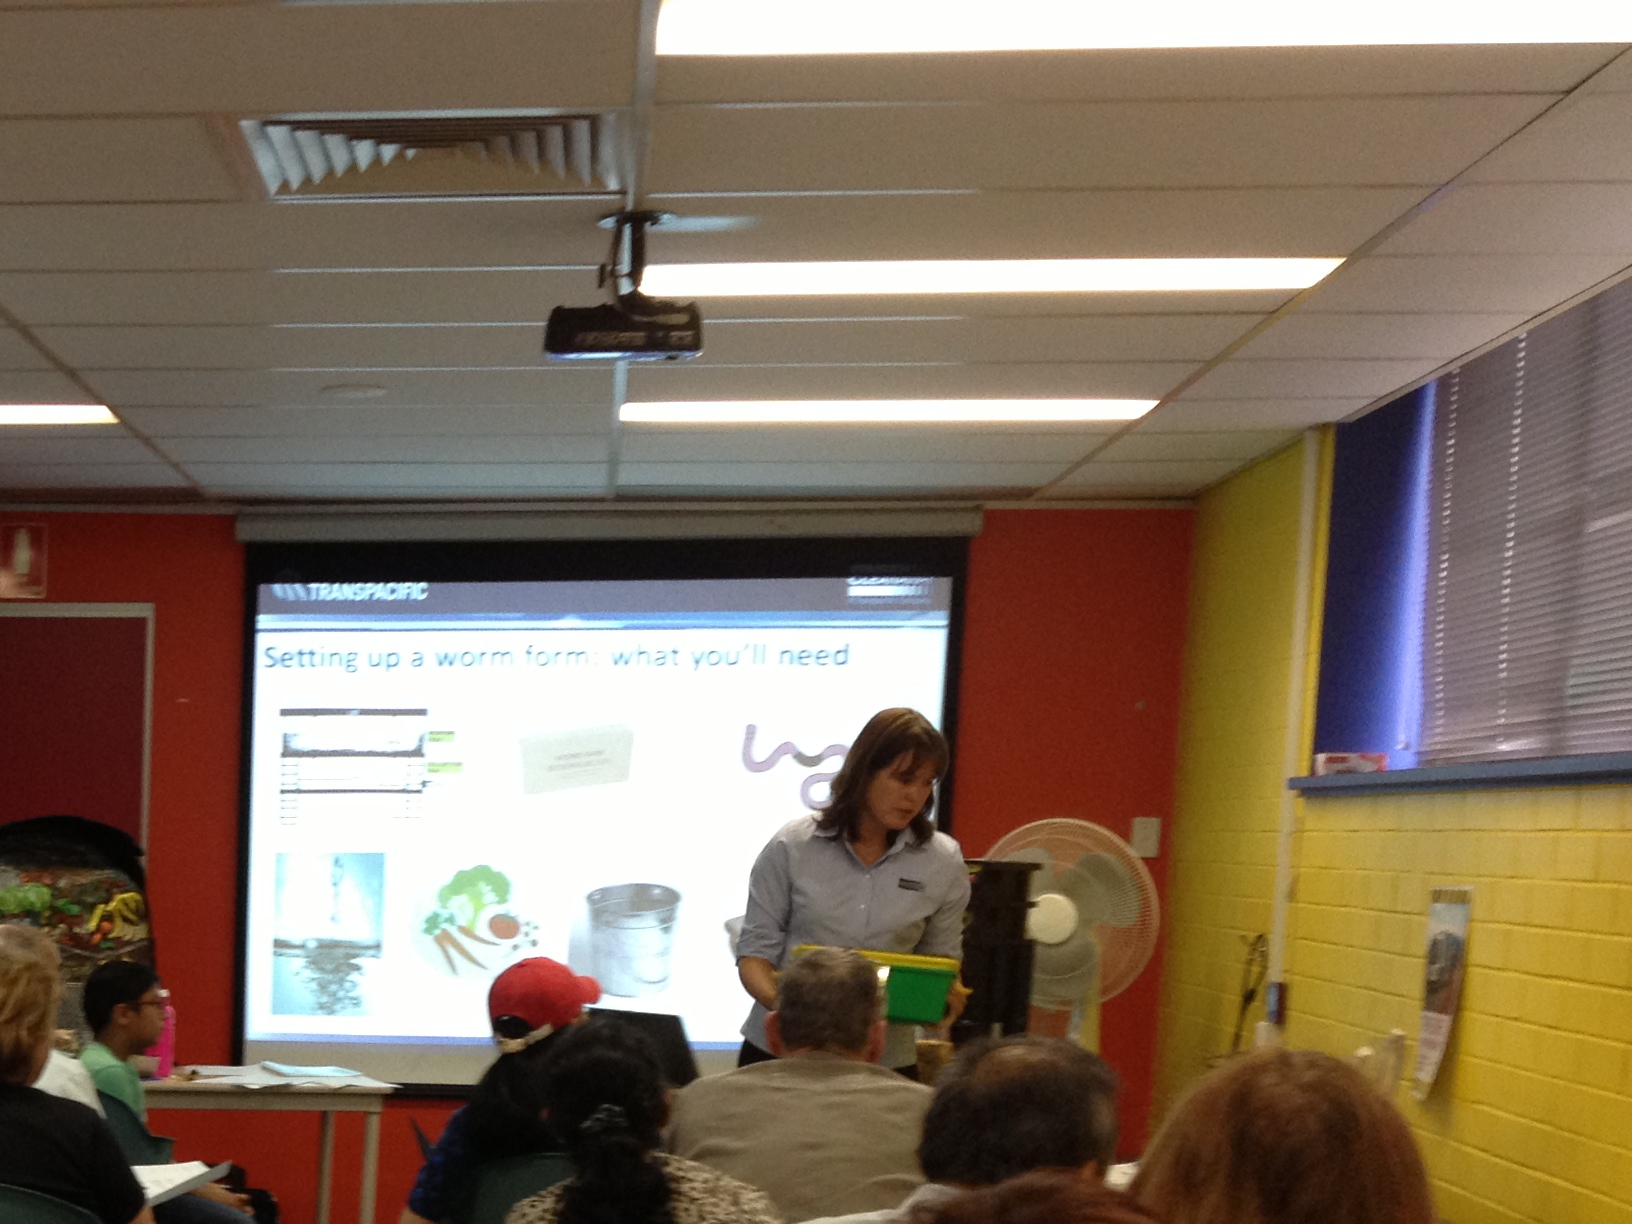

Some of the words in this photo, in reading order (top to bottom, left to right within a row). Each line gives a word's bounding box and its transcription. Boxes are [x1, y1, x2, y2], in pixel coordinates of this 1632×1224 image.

[307, 582, 429, 601] TRANSPACIFIC
[264, 646, 358, 673] Setting
[367, 651, 401, 672] up
[410, 650, 424, 667] a
[435, 649, 514, 667] worm
[611, 645, 680, 667] what
[690, 644, 766, 671] you'll
[778, 643, 850, 666] need
